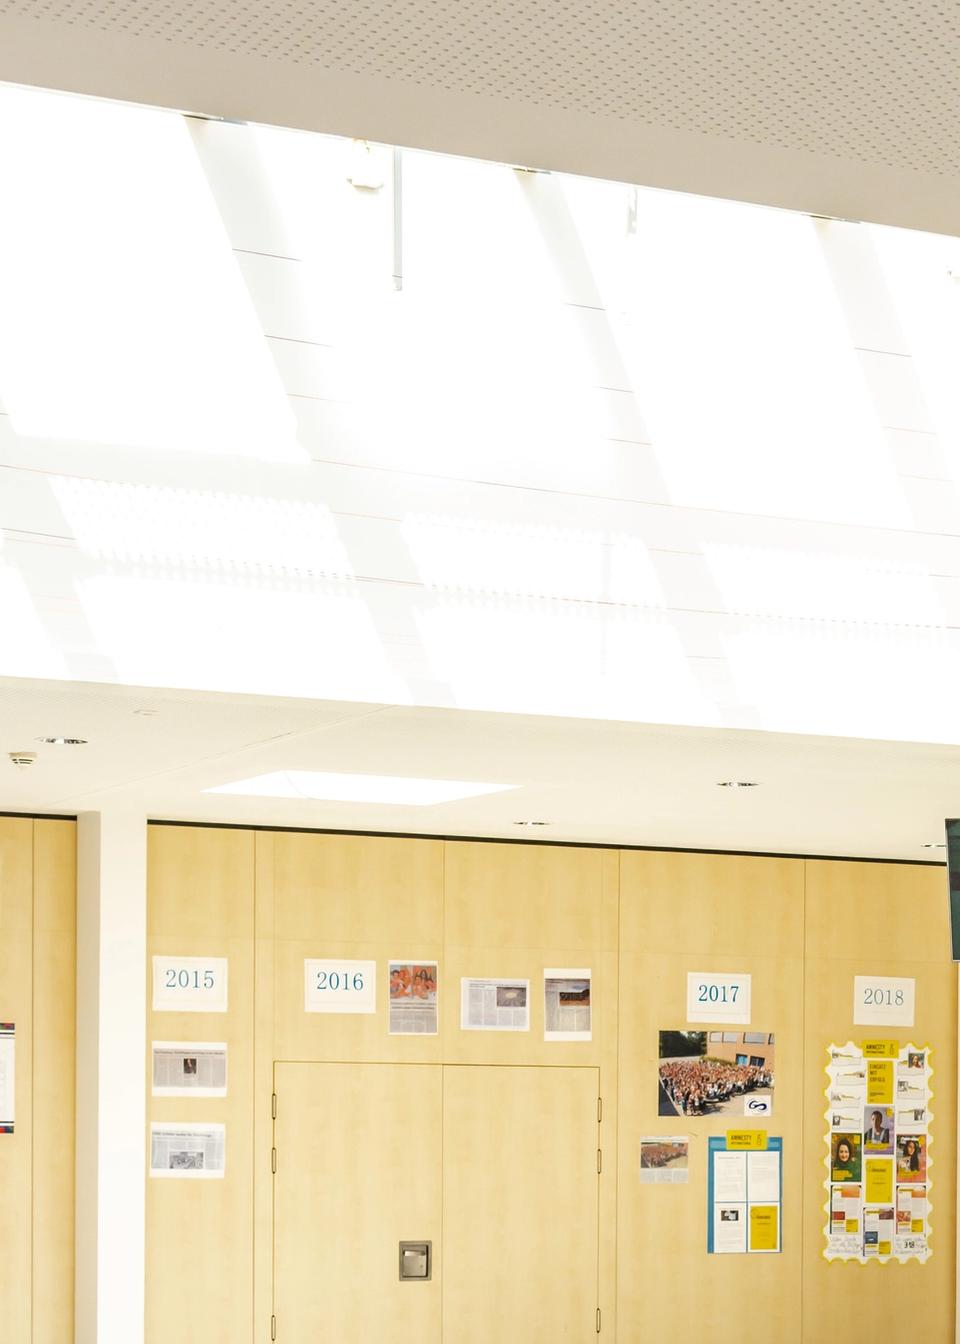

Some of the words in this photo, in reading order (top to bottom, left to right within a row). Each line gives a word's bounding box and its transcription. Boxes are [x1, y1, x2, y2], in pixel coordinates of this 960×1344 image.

[165, 969, 214, 989] 2015
[317, 972, 364, 990] 2016
[698, 985, 739, 1002] 2017
[864, 988, 904, 1006] 2018
